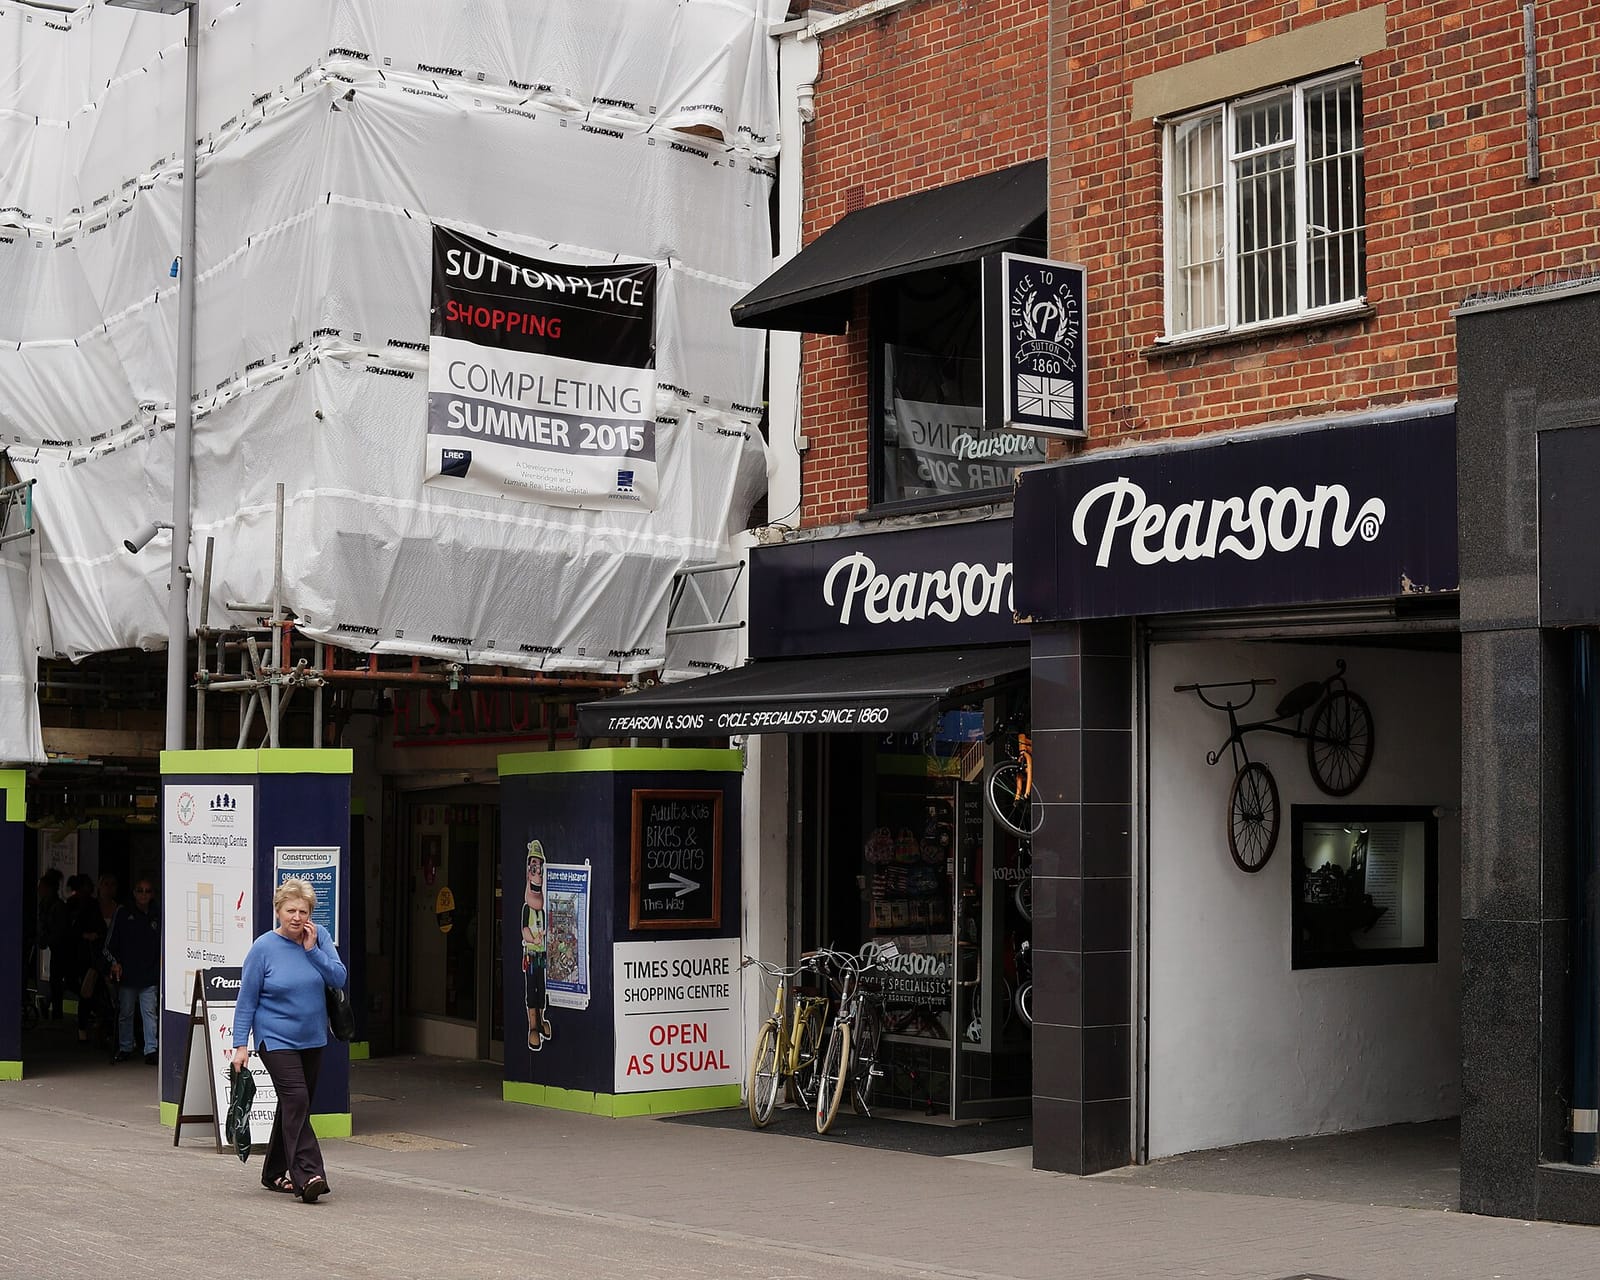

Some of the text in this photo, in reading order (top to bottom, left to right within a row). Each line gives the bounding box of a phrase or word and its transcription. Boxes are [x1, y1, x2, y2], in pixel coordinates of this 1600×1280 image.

[417, 63, 463, 78] Monarflex
[581, 124, 624, 140] Monarflex
[670, 142, 709, 159] Monarflex
[1040, 270, 1054, 285] TO
[1011, 274, 1034, 342] SERVICE
[1058, 283, 1080, 350] CYCLING
[446, 300, 562, 339] SHOPPING
[1031, 342, 1060, 354] SUTTON
[366, 365, 414, 380] Monarflex
[1032, 358, 1061, 374] 1860
[448, 360, 642, 414] COMPLETING
[448, 400, 645, 452] SUMMER 2015
[951, 432, 1035, 460] Pearson
[444, 451, 464, 460] LREC
[522, 462, 566, 475] Development
[566, 469, 574, 477] by
[504, 478, 588, 495] Lumina Real Estate Capital
[559, 476, 572, 484] and
[1072, 476, 1386, 568] Pearson
[337, 623, 378, 636] Monarflex
[666, 716, 674, 730] &
[675, 715, 704, 730] SONS
[717, 713, 750, 728] CYCLE
[750, 710, 816, 726] SPECIALISTS
[818, 708, 856, 724] SINCE
[857, 708, 890, 724] 1860
[169, 832, 248, 848] Times Square Shopping Centre
[684, 826, 697, 846] &
[187, 852, 226, 864] North Entrance
[282, 853, 328, 861] Construction
[282, 872, 332, 880] 0845 605 1956
[186, 947, 226, 964] South Entrance
[624, 958, 730, 980] TIMES SQUARE
[624, 984, 730, 1002] SHOPPING CENTRE
[888, 980, 946, 995] SPECIALISTS
[649, 1022, 708, 1046] OPEN
[626, 1050, 730, 1076] AS USUAL
